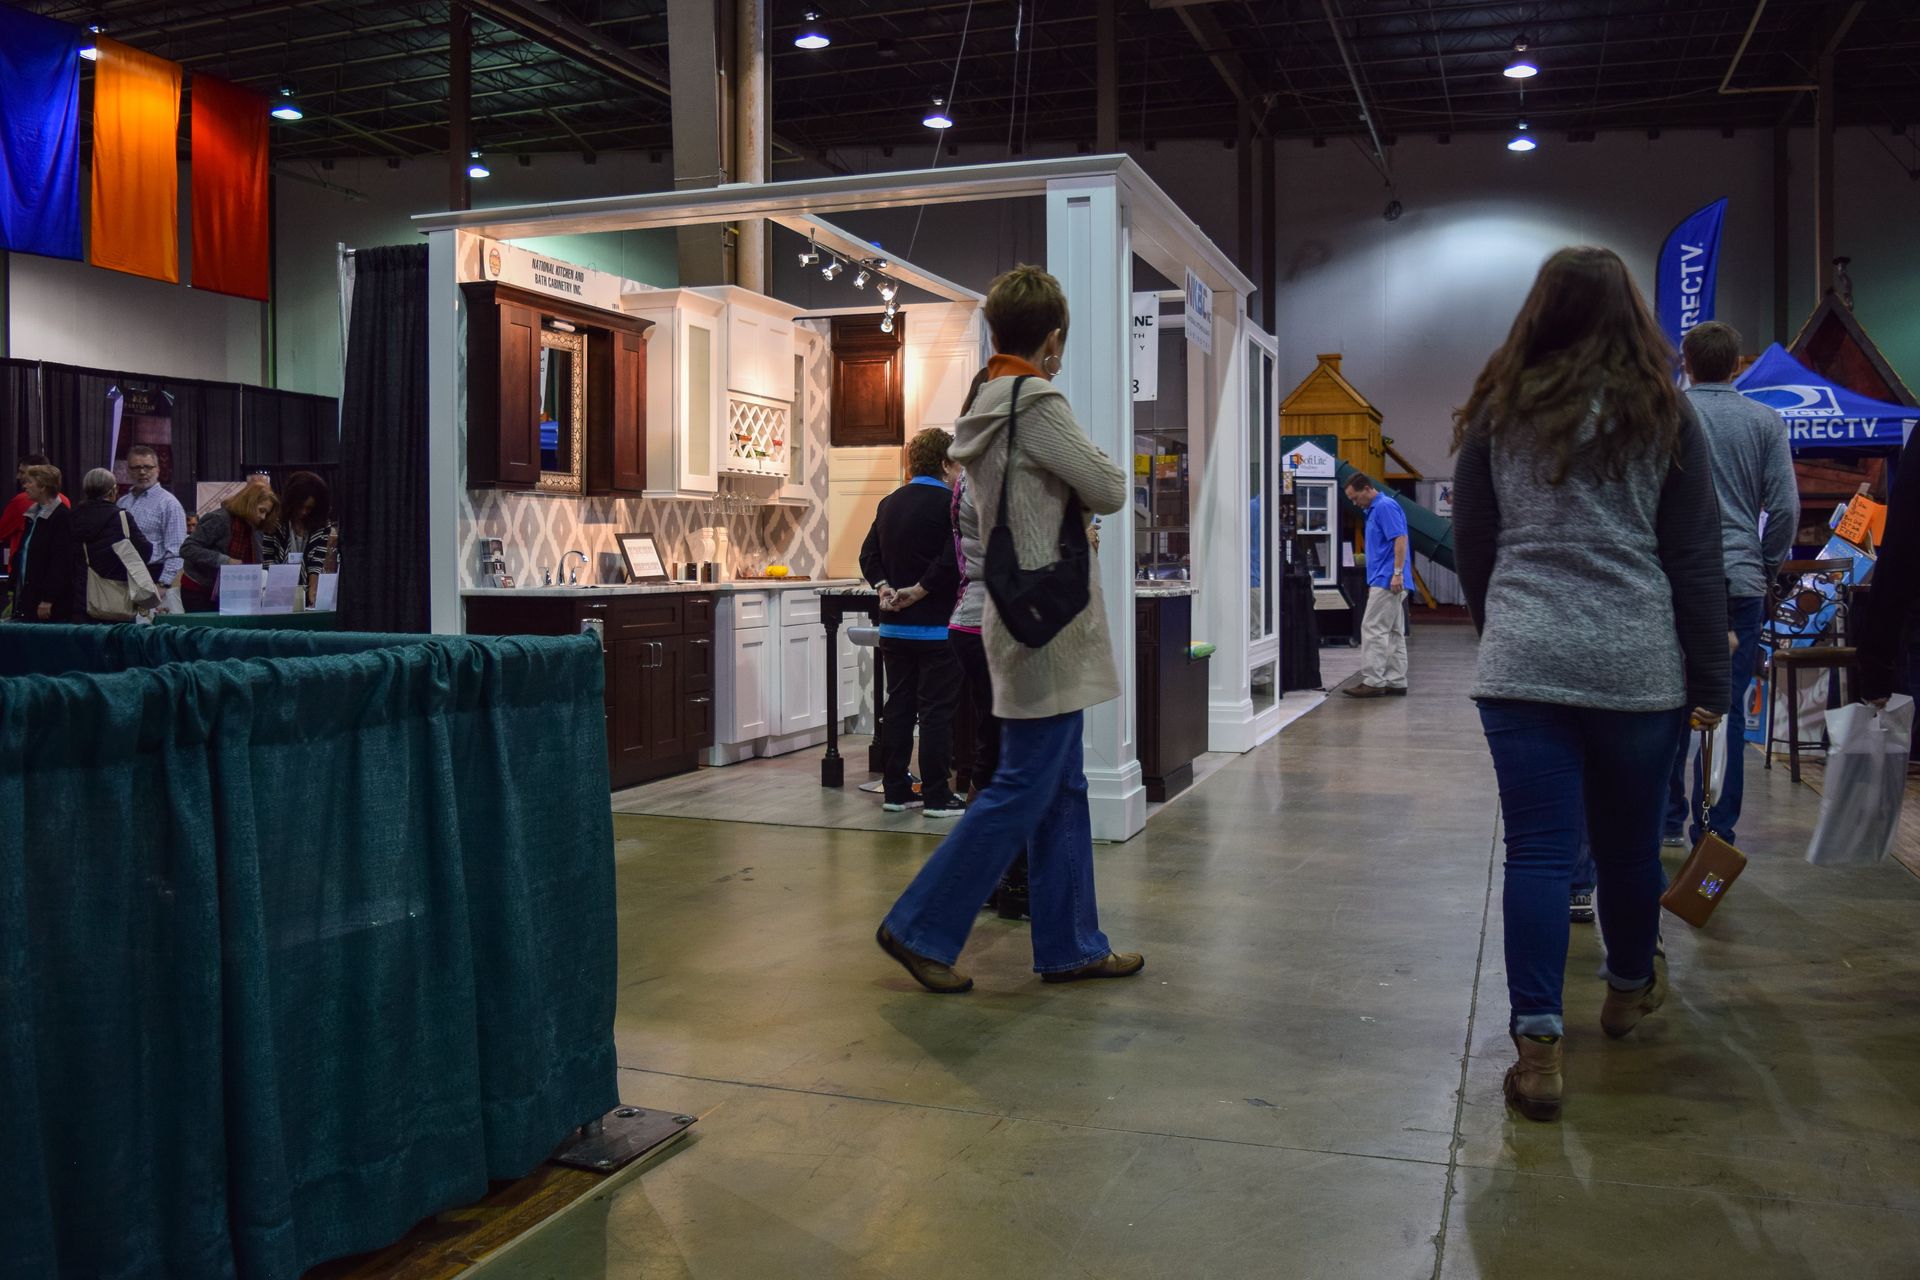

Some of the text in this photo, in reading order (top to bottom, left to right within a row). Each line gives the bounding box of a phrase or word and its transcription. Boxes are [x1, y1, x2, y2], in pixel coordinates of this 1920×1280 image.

[532, 258, 584, 283] NATIONAL KITCHEN AND
[534, 273, 582, 296] BATH CABINETRY INC.
